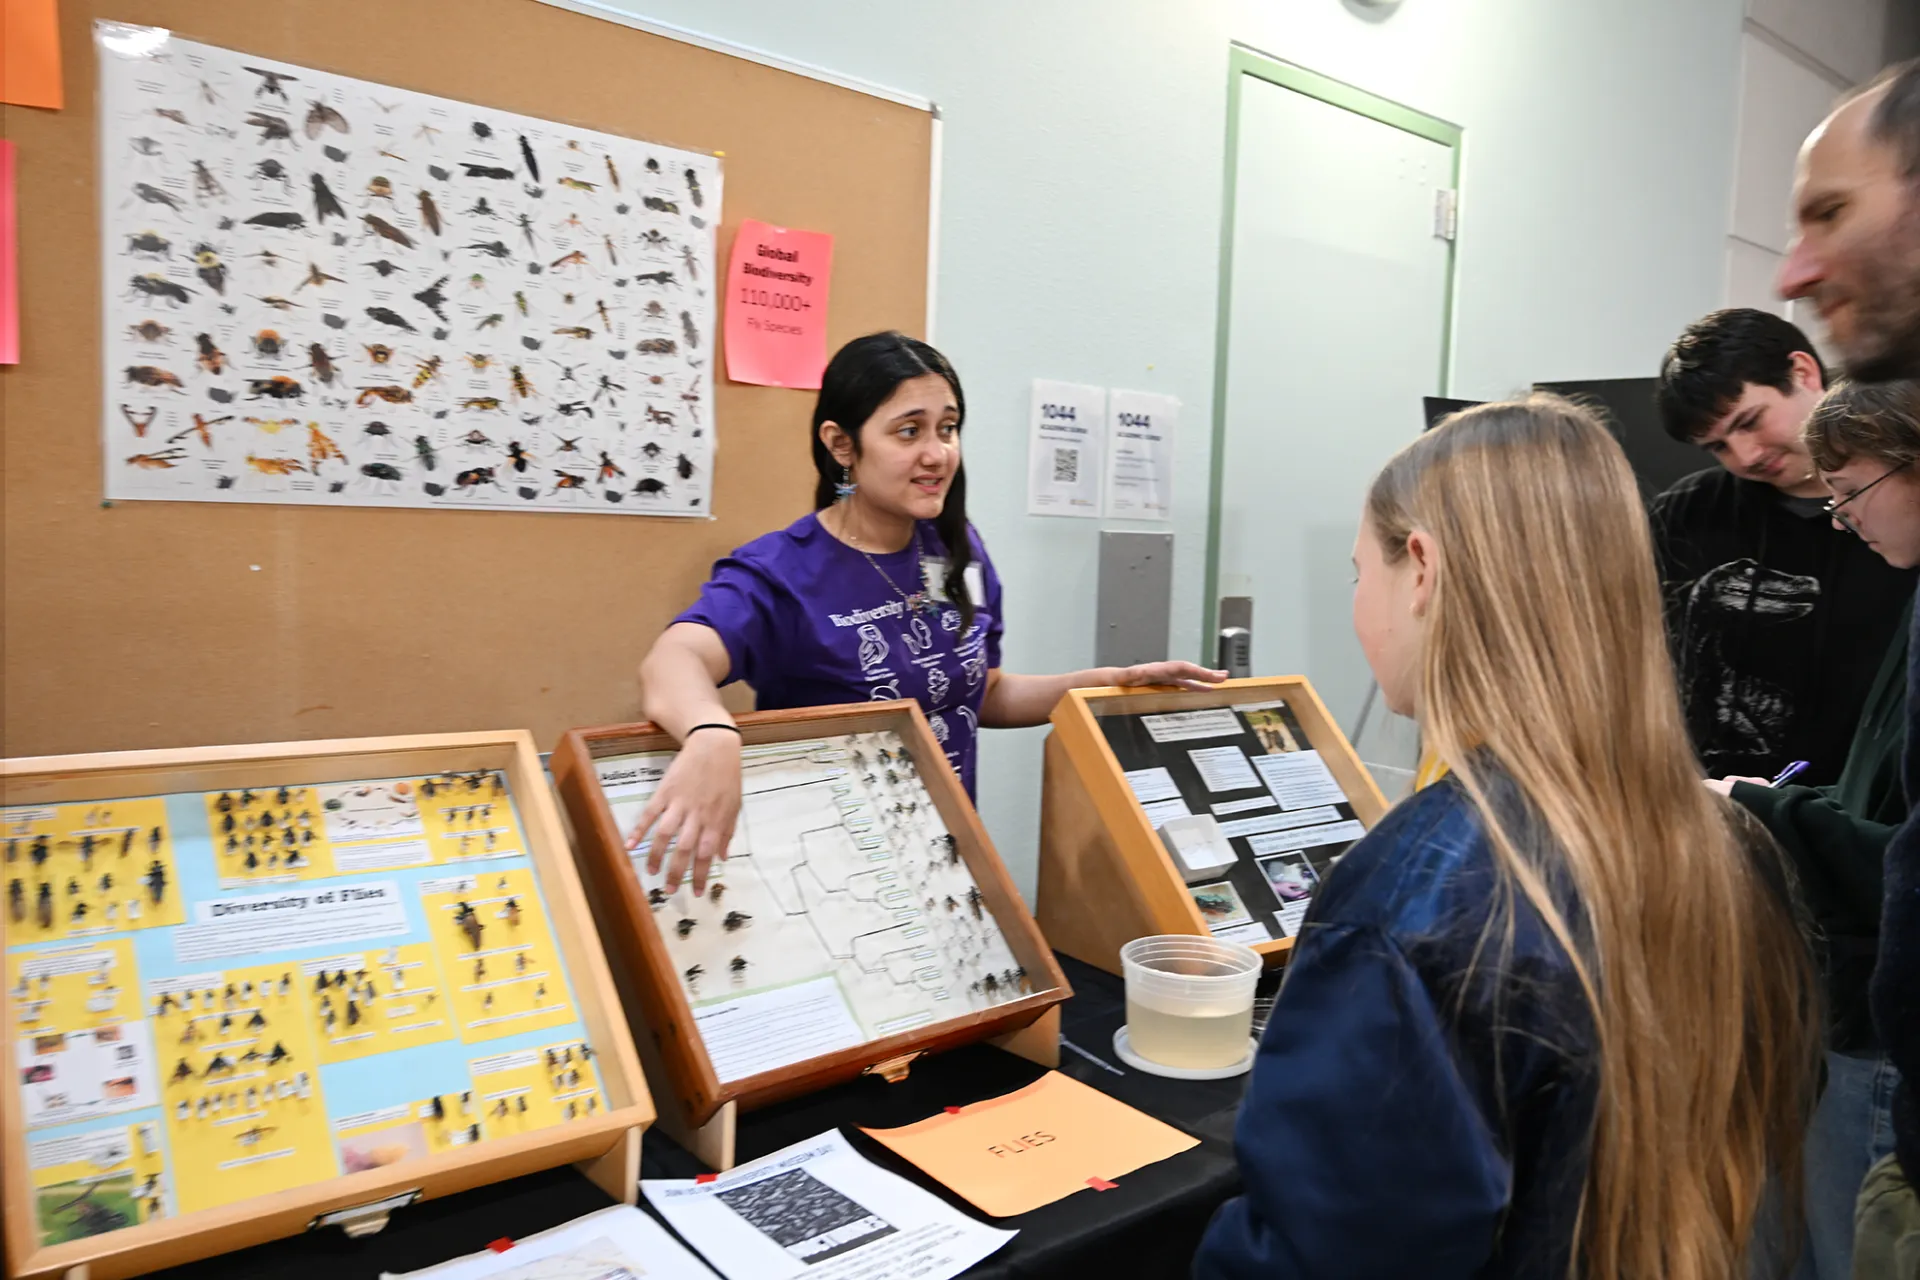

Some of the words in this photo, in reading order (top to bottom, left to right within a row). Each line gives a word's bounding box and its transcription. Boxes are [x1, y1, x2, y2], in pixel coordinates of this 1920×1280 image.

[756, 243, 799, 263] Global
[742, 262, 813, 286] Biodiversity
[740, 287, 812, 312] 110,000+
[747, 317, 762, 331] Fly
[763, 319, 804, 336] Species
[1041, 403, 1076, 421] 1044
[1118, 412, 1151, 429] 1044
[828, 600, 904, 628] Biodiversity
[212, 896, 308, 916] Diversity
[315, 890, 334, 905] of
[340, 886, 386, 903] Flies
[987, 1130, 1057, 1159] FLIES
